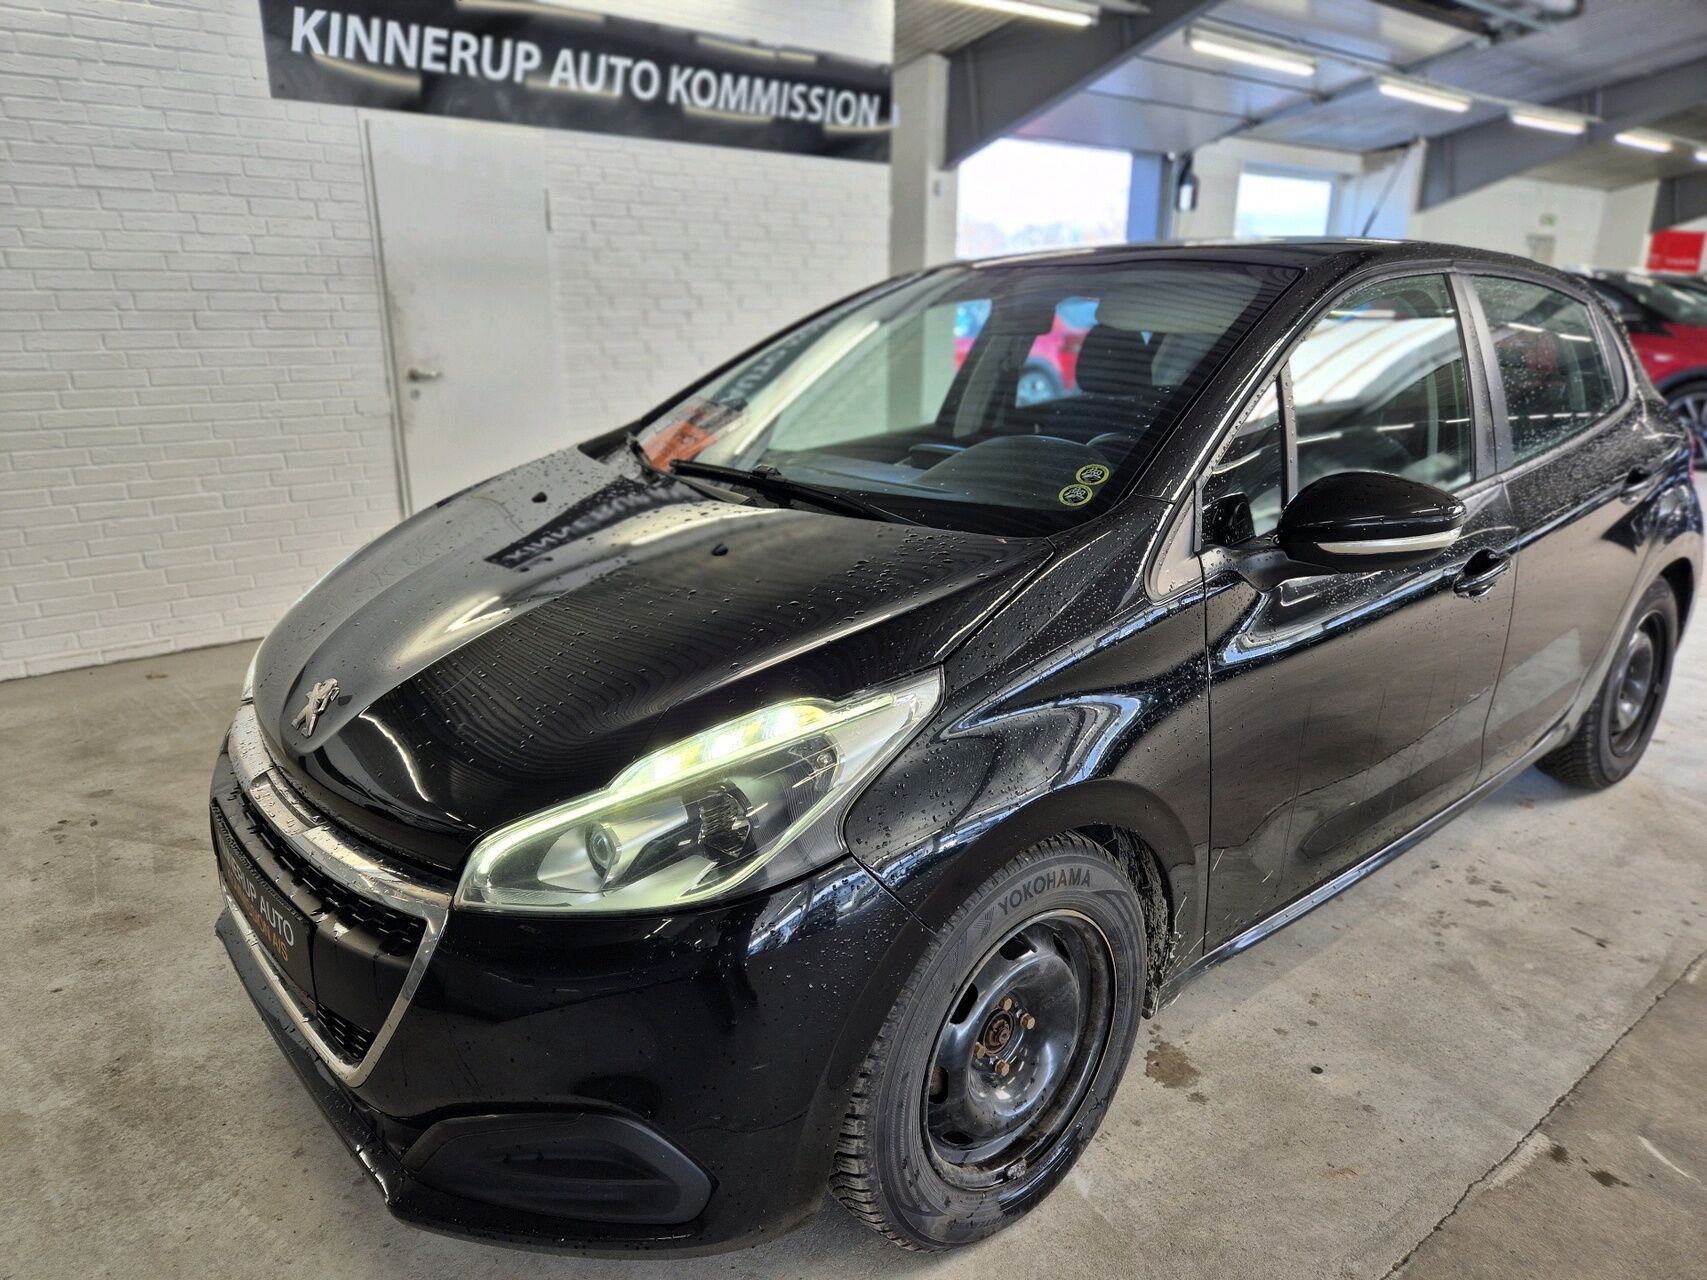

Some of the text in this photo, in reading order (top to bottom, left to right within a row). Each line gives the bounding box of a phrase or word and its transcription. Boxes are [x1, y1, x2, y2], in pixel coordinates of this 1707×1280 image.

[291, 7, 541, 84] KINNERUP
[549, 48, 660, 100] AUTO
[668, 67, 881, 129] KOMMISSION
[998, 868, 1091, 915] YOKOHAMA
[260, 895, 295, 947] AUTO
